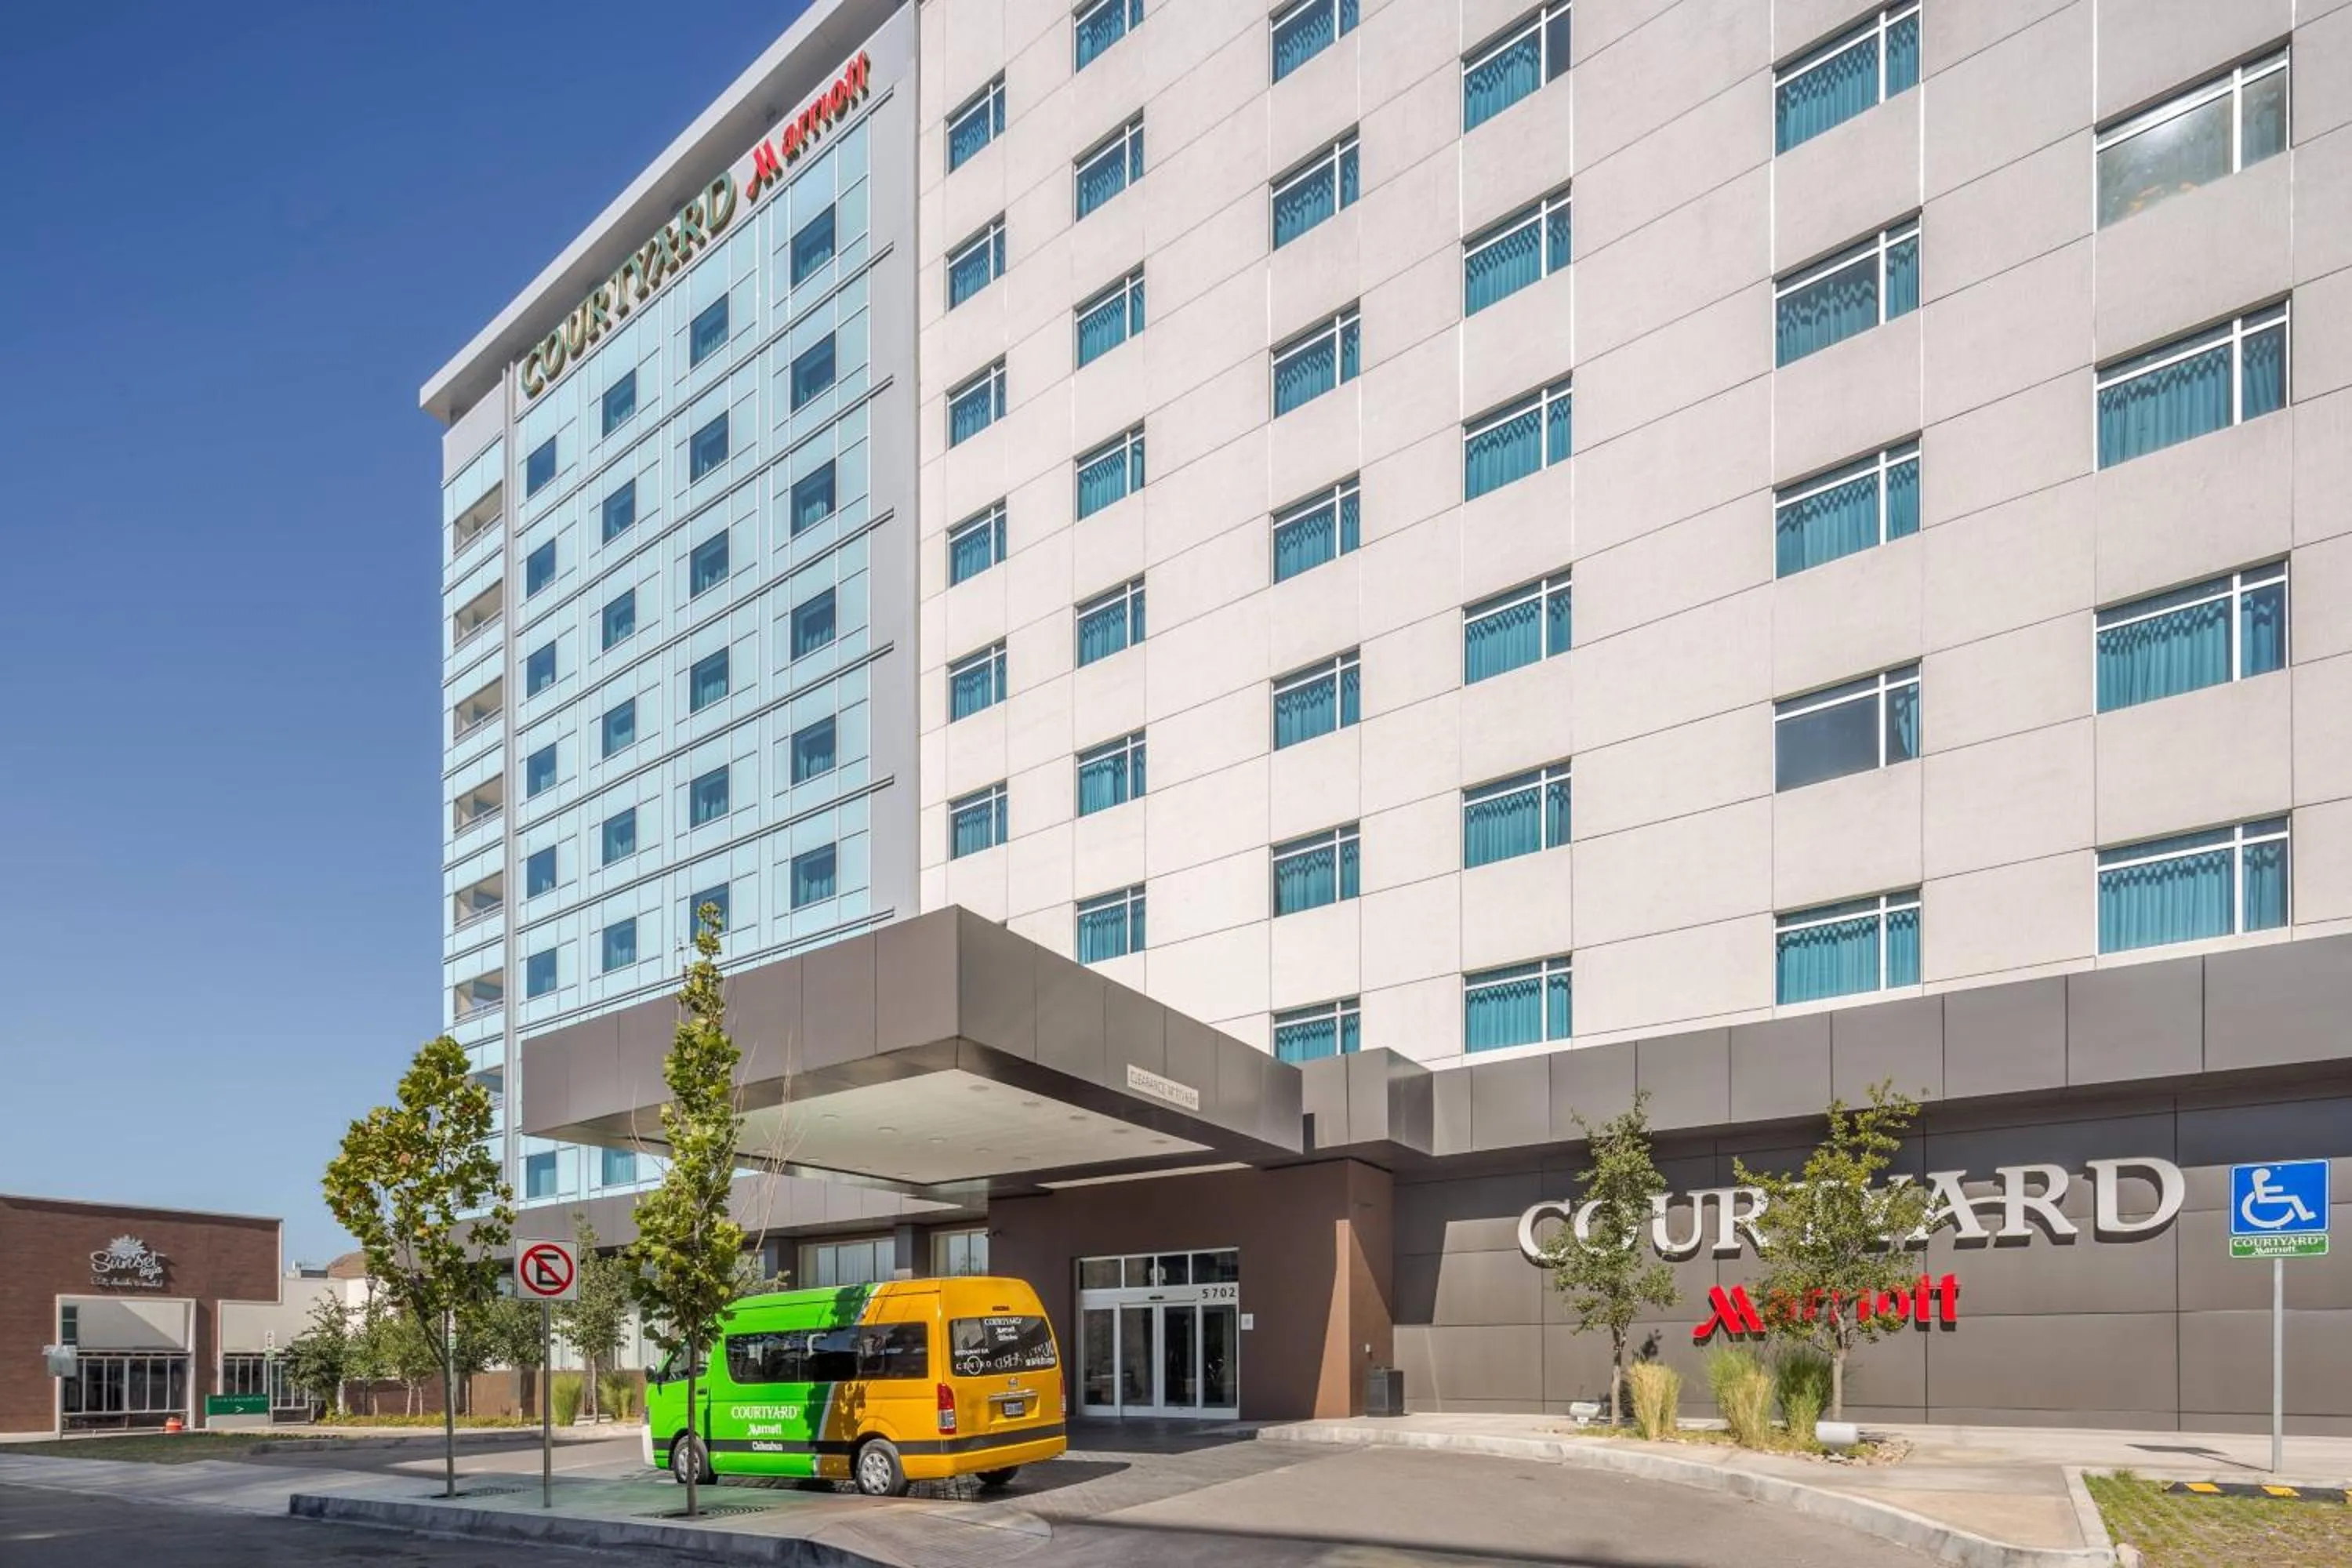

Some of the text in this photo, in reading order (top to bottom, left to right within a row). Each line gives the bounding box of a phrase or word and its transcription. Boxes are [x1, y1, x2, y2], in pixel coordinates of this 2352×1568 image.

[521, 49, 871, 401] COURTYARD Marriott
[1517, 1156, 2186, 1261] COURARD
[2234, 1234, 2318, 1247] COURTYARD
[90, 1250, 167, 1272] Sunset
[536, 1254, 562, 1286] E
[1202, 1287, 1236, 1299] 5702
[731, 1405, 797, 1420] COURTYARD
